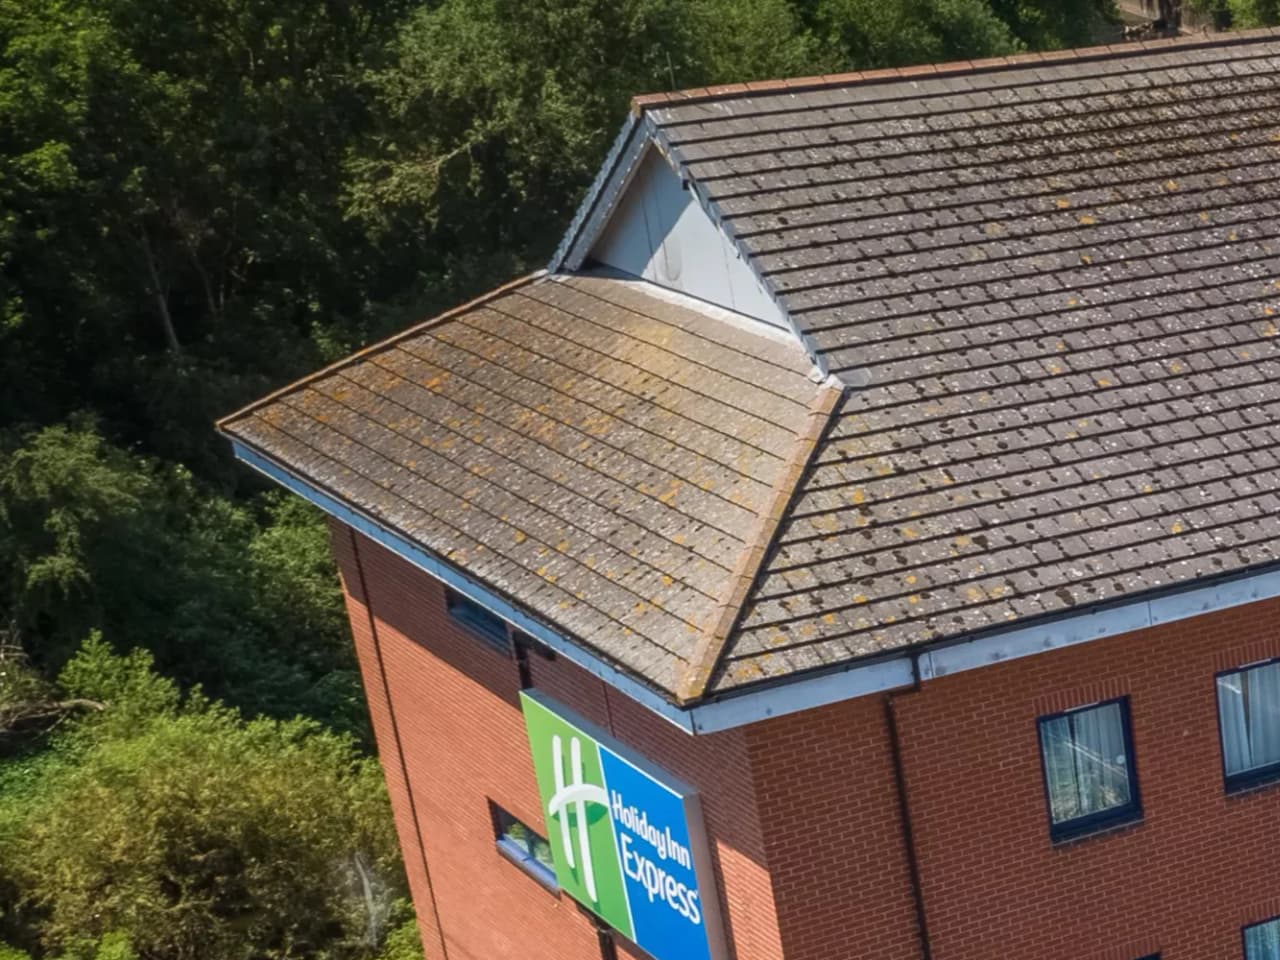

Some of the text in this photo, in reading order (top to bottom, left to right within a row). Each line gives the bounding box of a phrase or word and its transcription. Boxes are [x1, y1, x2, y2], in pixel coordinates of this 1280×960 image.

[612, 790, 691, 870] Holiday Inn
[621, 832, 700, 925] Express
